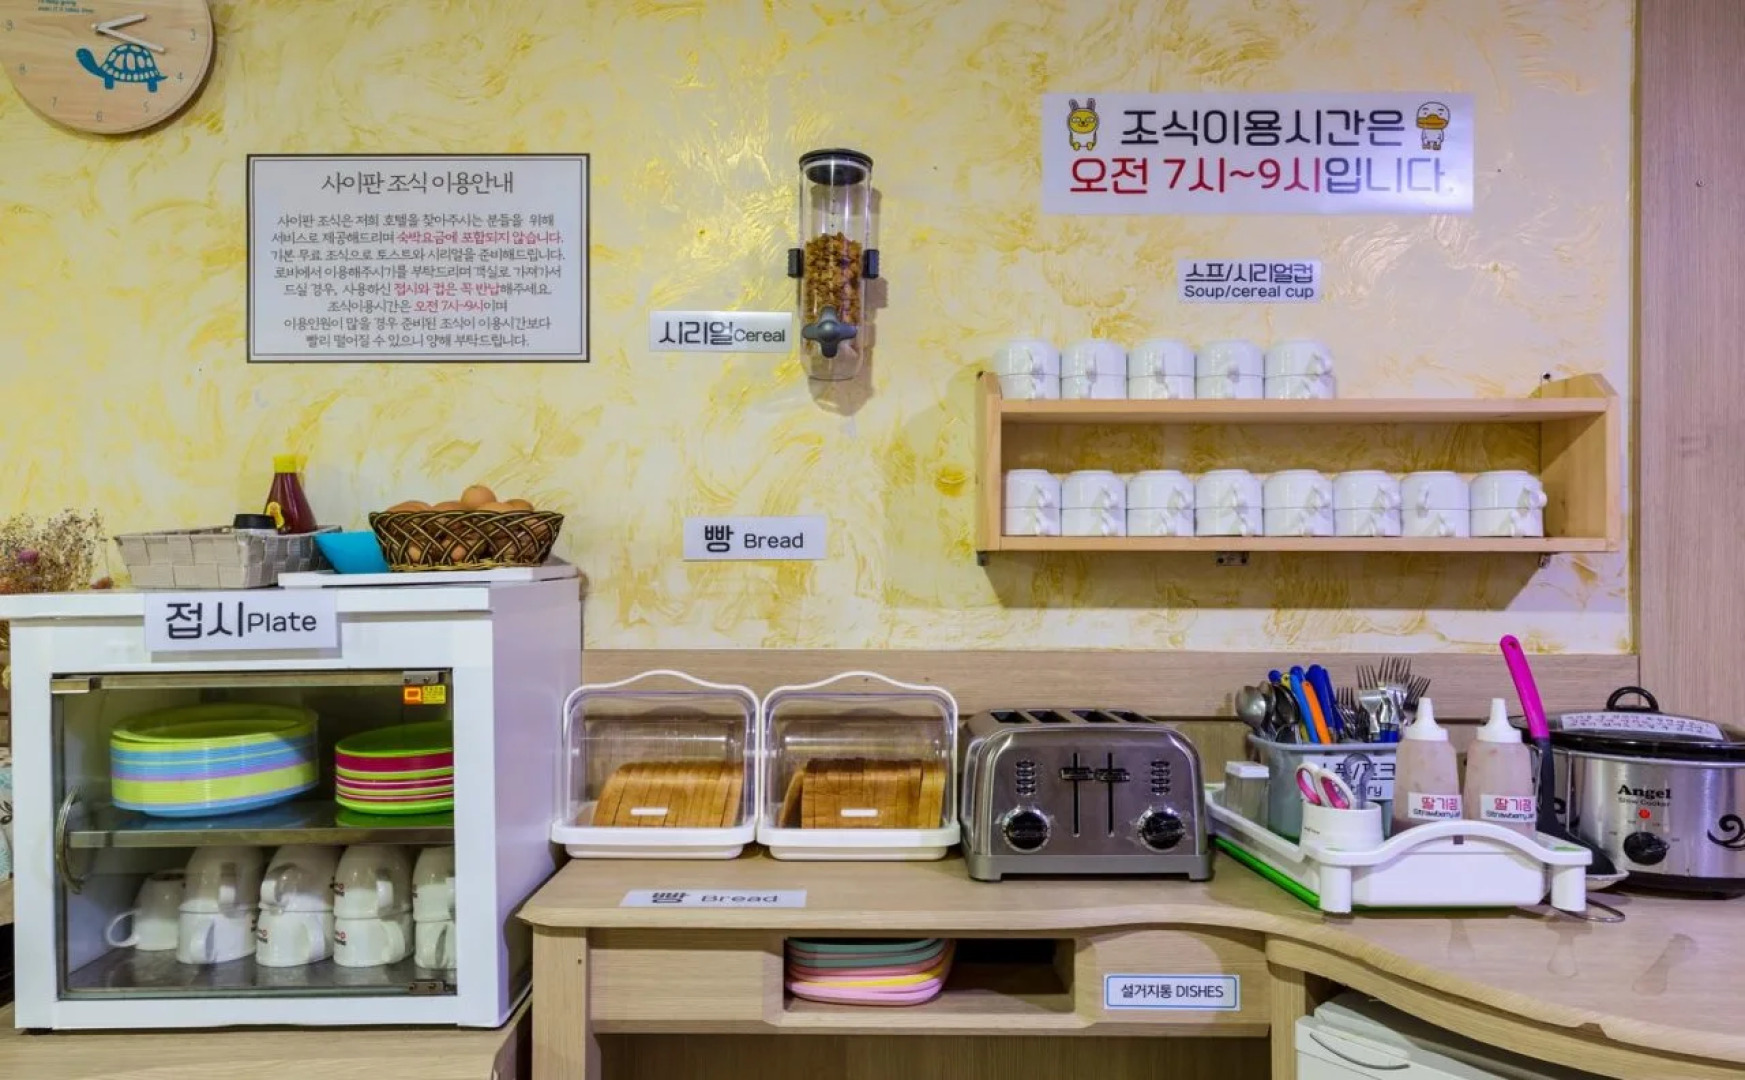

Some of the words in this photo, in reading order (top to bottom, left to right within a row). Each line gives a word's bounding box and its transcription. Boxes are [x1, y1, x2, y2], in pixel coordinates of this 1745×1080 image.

[1120, 110, 1405, 147] 조식이용시간은
[321, 171, 385, 195] 사이판
[387, 171, 428, 195] 조식
[432, 171, 514, 195] 이용안내
[1070, 157, 1149, 194] 오전
[318, 213, 353, 228] 조식은
[382, 213, 420, 228] 호텔을
[423, 213, 484, 228] 찾아주시는
[487, 213, 523, 228] 분들을
[530, 213, 555, 228] 위해
[397, 231, 458, 245] 숙박요금에
[326, 248, 374, 262] 조식으로
[1184, 262, 1315, 283] 스프/시리얼컵
[1184, 284, 1281, 299] Soup/cereal
[1285, 286, 1315, 299] cup
[372, 333, 386, 348] 수
[704, 524, 734, 553] 빵
[744, 532, 804, 549] Bread
[1618, 784, 1672, 799] Angel
[652, 892, 689, 904] 빵
[701, 892, 779, 903] Bread
[1121, 983, 1173, 999] 설거지통
[1176, 985, 1224, 999] DISHES
